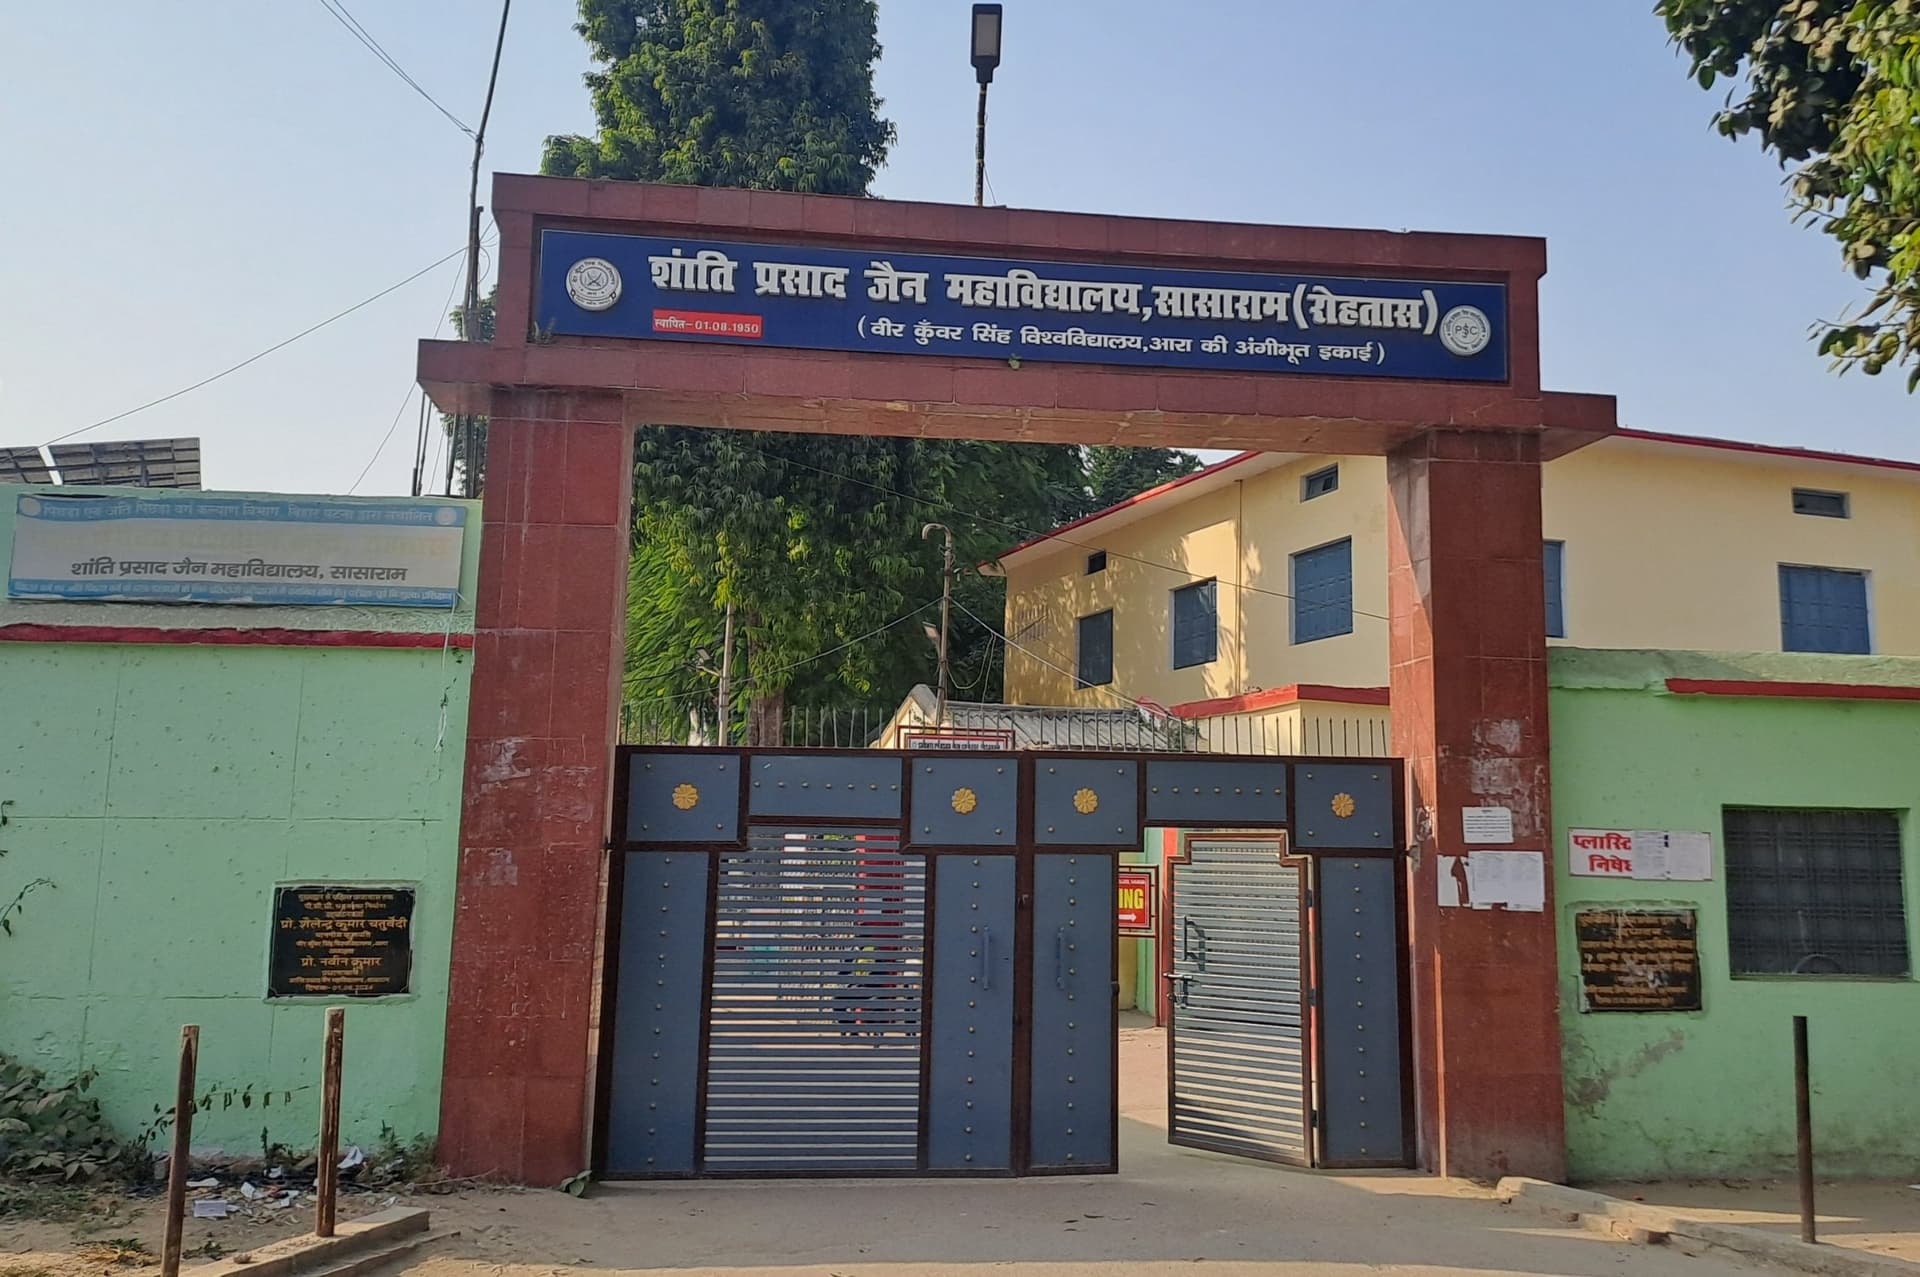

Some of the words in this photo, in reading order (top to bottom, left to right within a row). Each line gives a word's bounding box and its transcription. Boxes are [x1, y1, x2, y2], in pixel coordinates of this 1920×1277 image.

[648, 248, 738, 293] शांति
[753, 261, 850, 300] प्रसाद
[864, 261, 930, 305] जैन
[914, 319, 963, 345] कुँवर
[972, 320, 1012, 346] सिंह
[1201, 334, 1228, 355] की
[1235, 335, 1311, 364] अंगीभूत
[71, 556, 115, 576] शांति
[119, 560, 168, 577] प्रसाद
[172, 556, 208, 576] जैन
[330, 565, 408, 582] सासाराम
